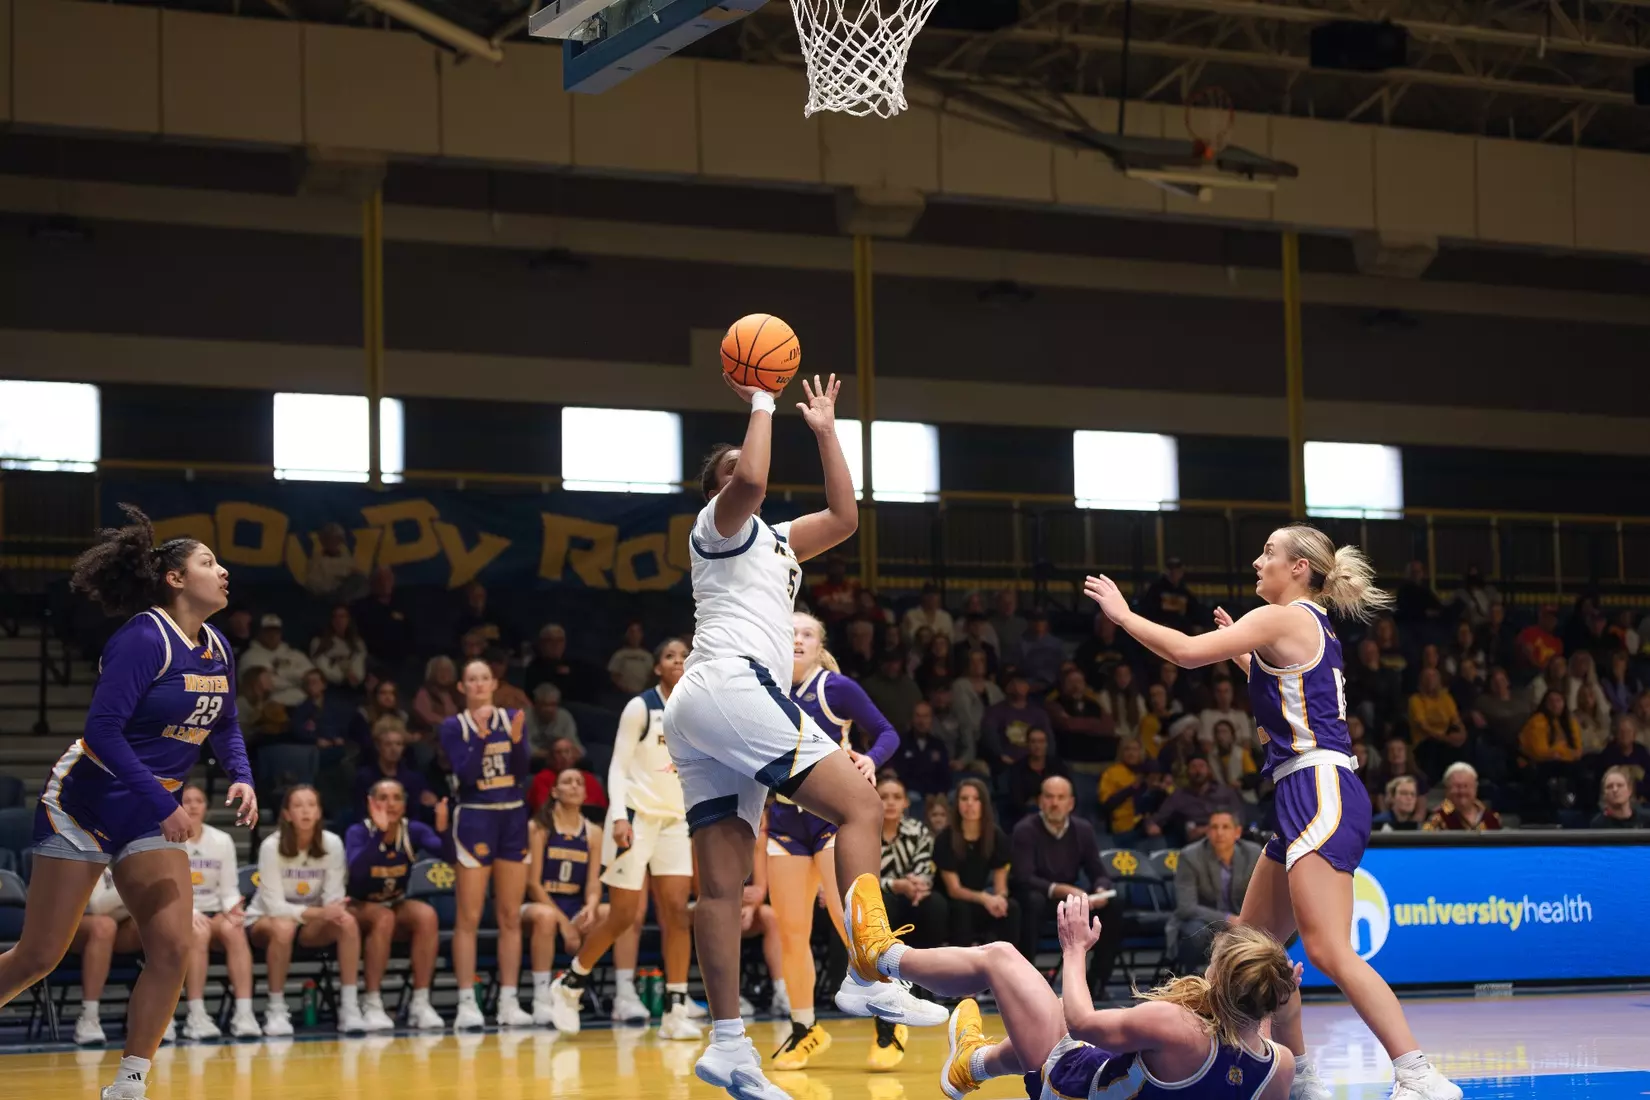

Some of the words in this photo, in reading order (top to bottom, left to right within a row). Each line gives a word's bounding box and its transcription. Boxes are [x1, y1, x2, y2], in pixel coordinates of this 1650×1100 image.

[183, 695, 223, 726] 23
[482, 754, 506, 778] 24
[559, 860, 572, 882] 0
